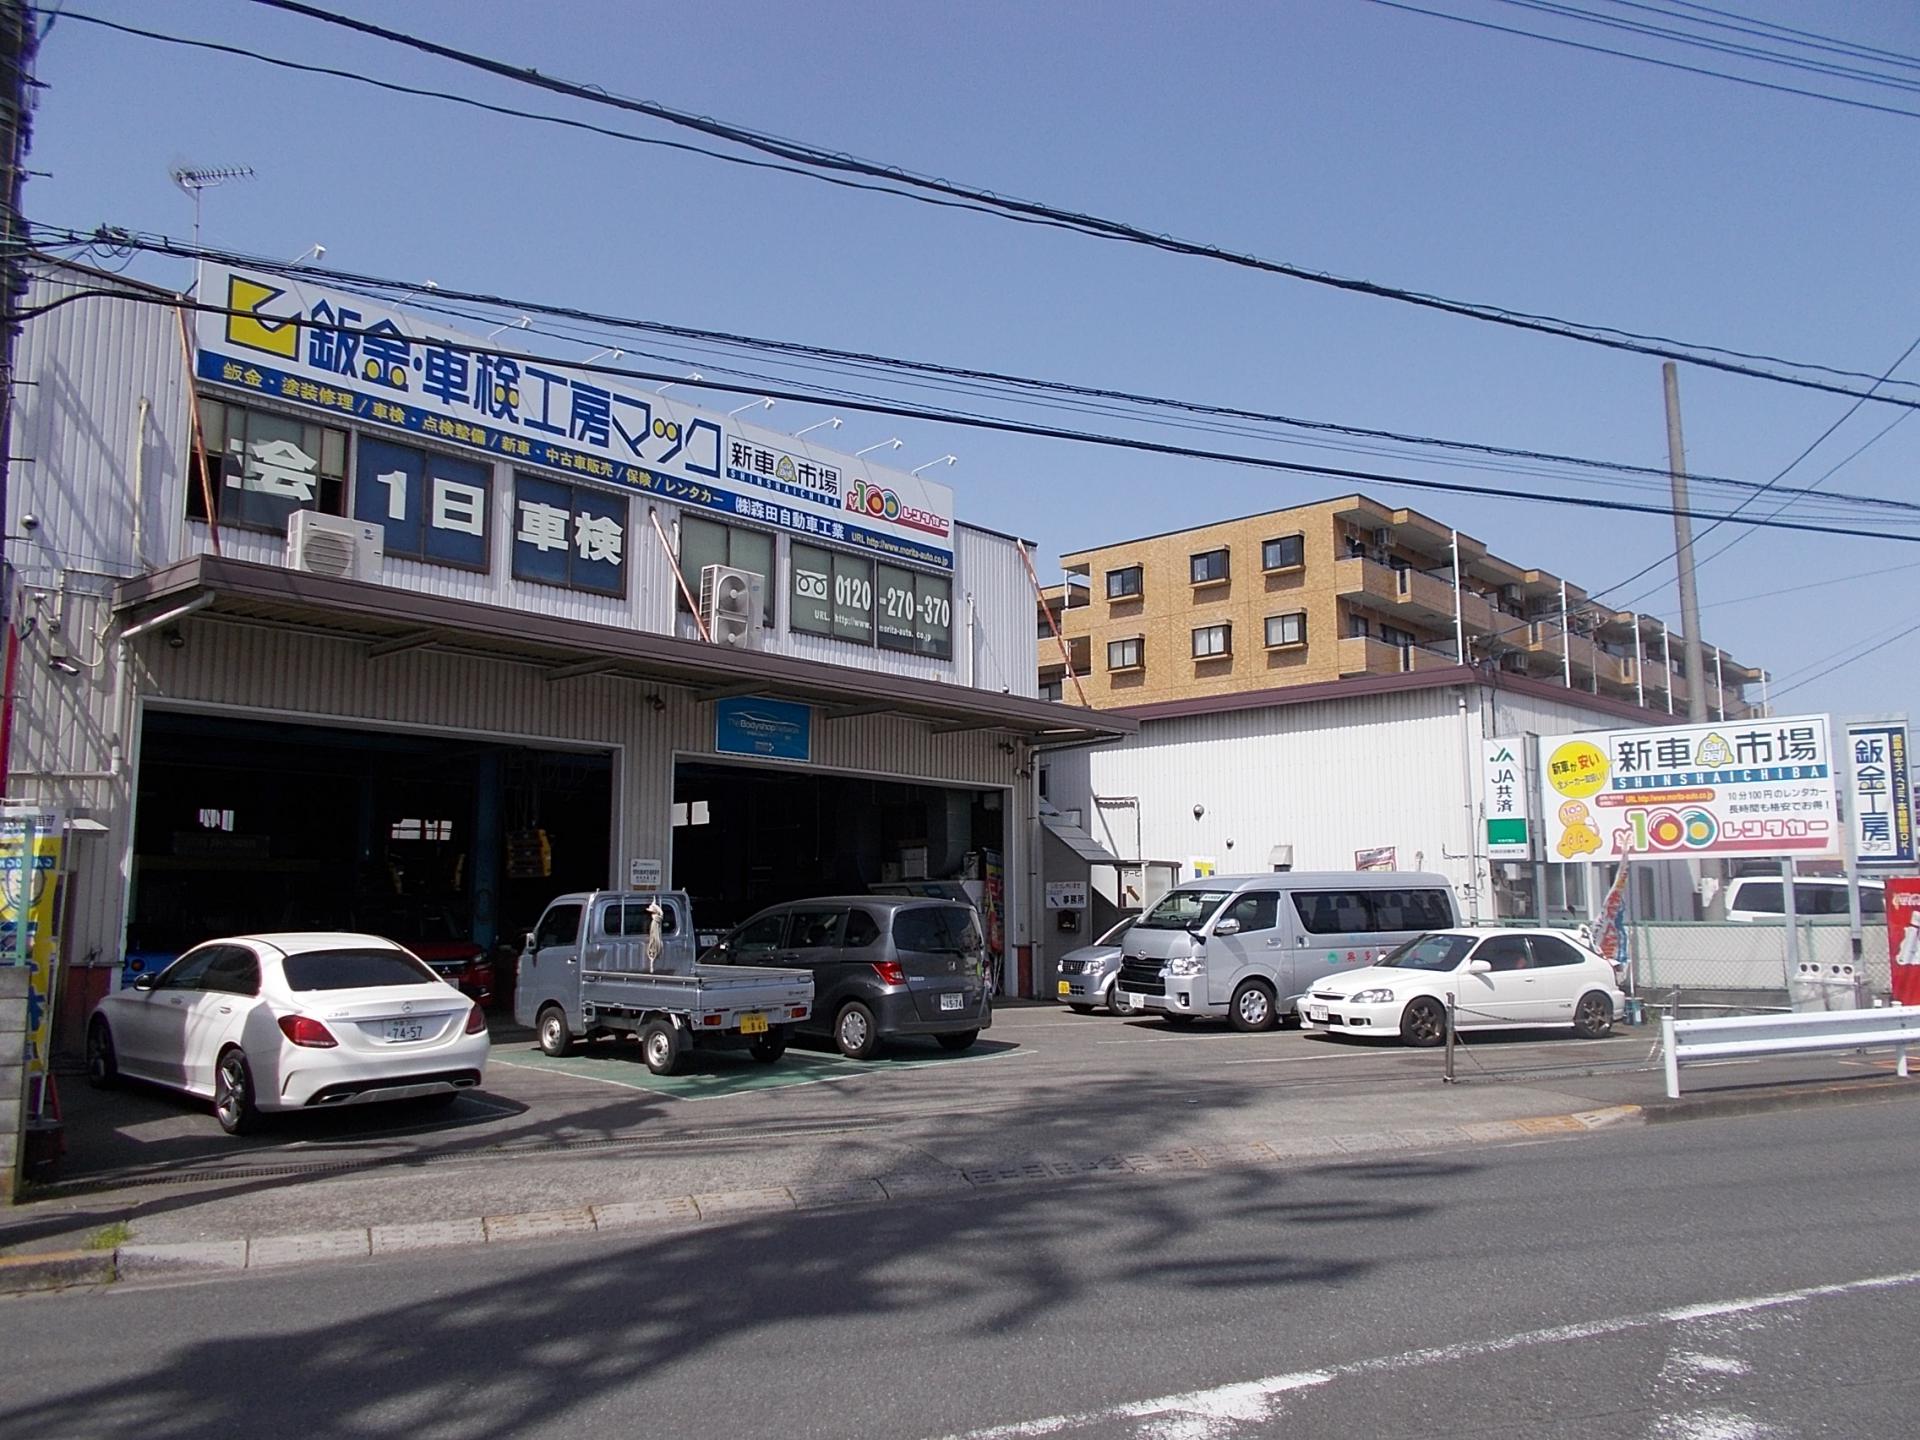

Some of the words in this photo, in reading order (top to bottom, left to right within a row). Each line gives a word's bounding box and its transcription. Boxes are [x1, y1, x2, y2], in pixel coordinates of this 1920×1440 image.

[518, 499, 622, 566] 車検
[1617, 740, 1692, 773] 新車
[1735, 727, 1816, 766] 市場
[1618, 765, 1821, 790] SHINSHAICHIBA
[392, 1025, 423, 1040] 74-57
